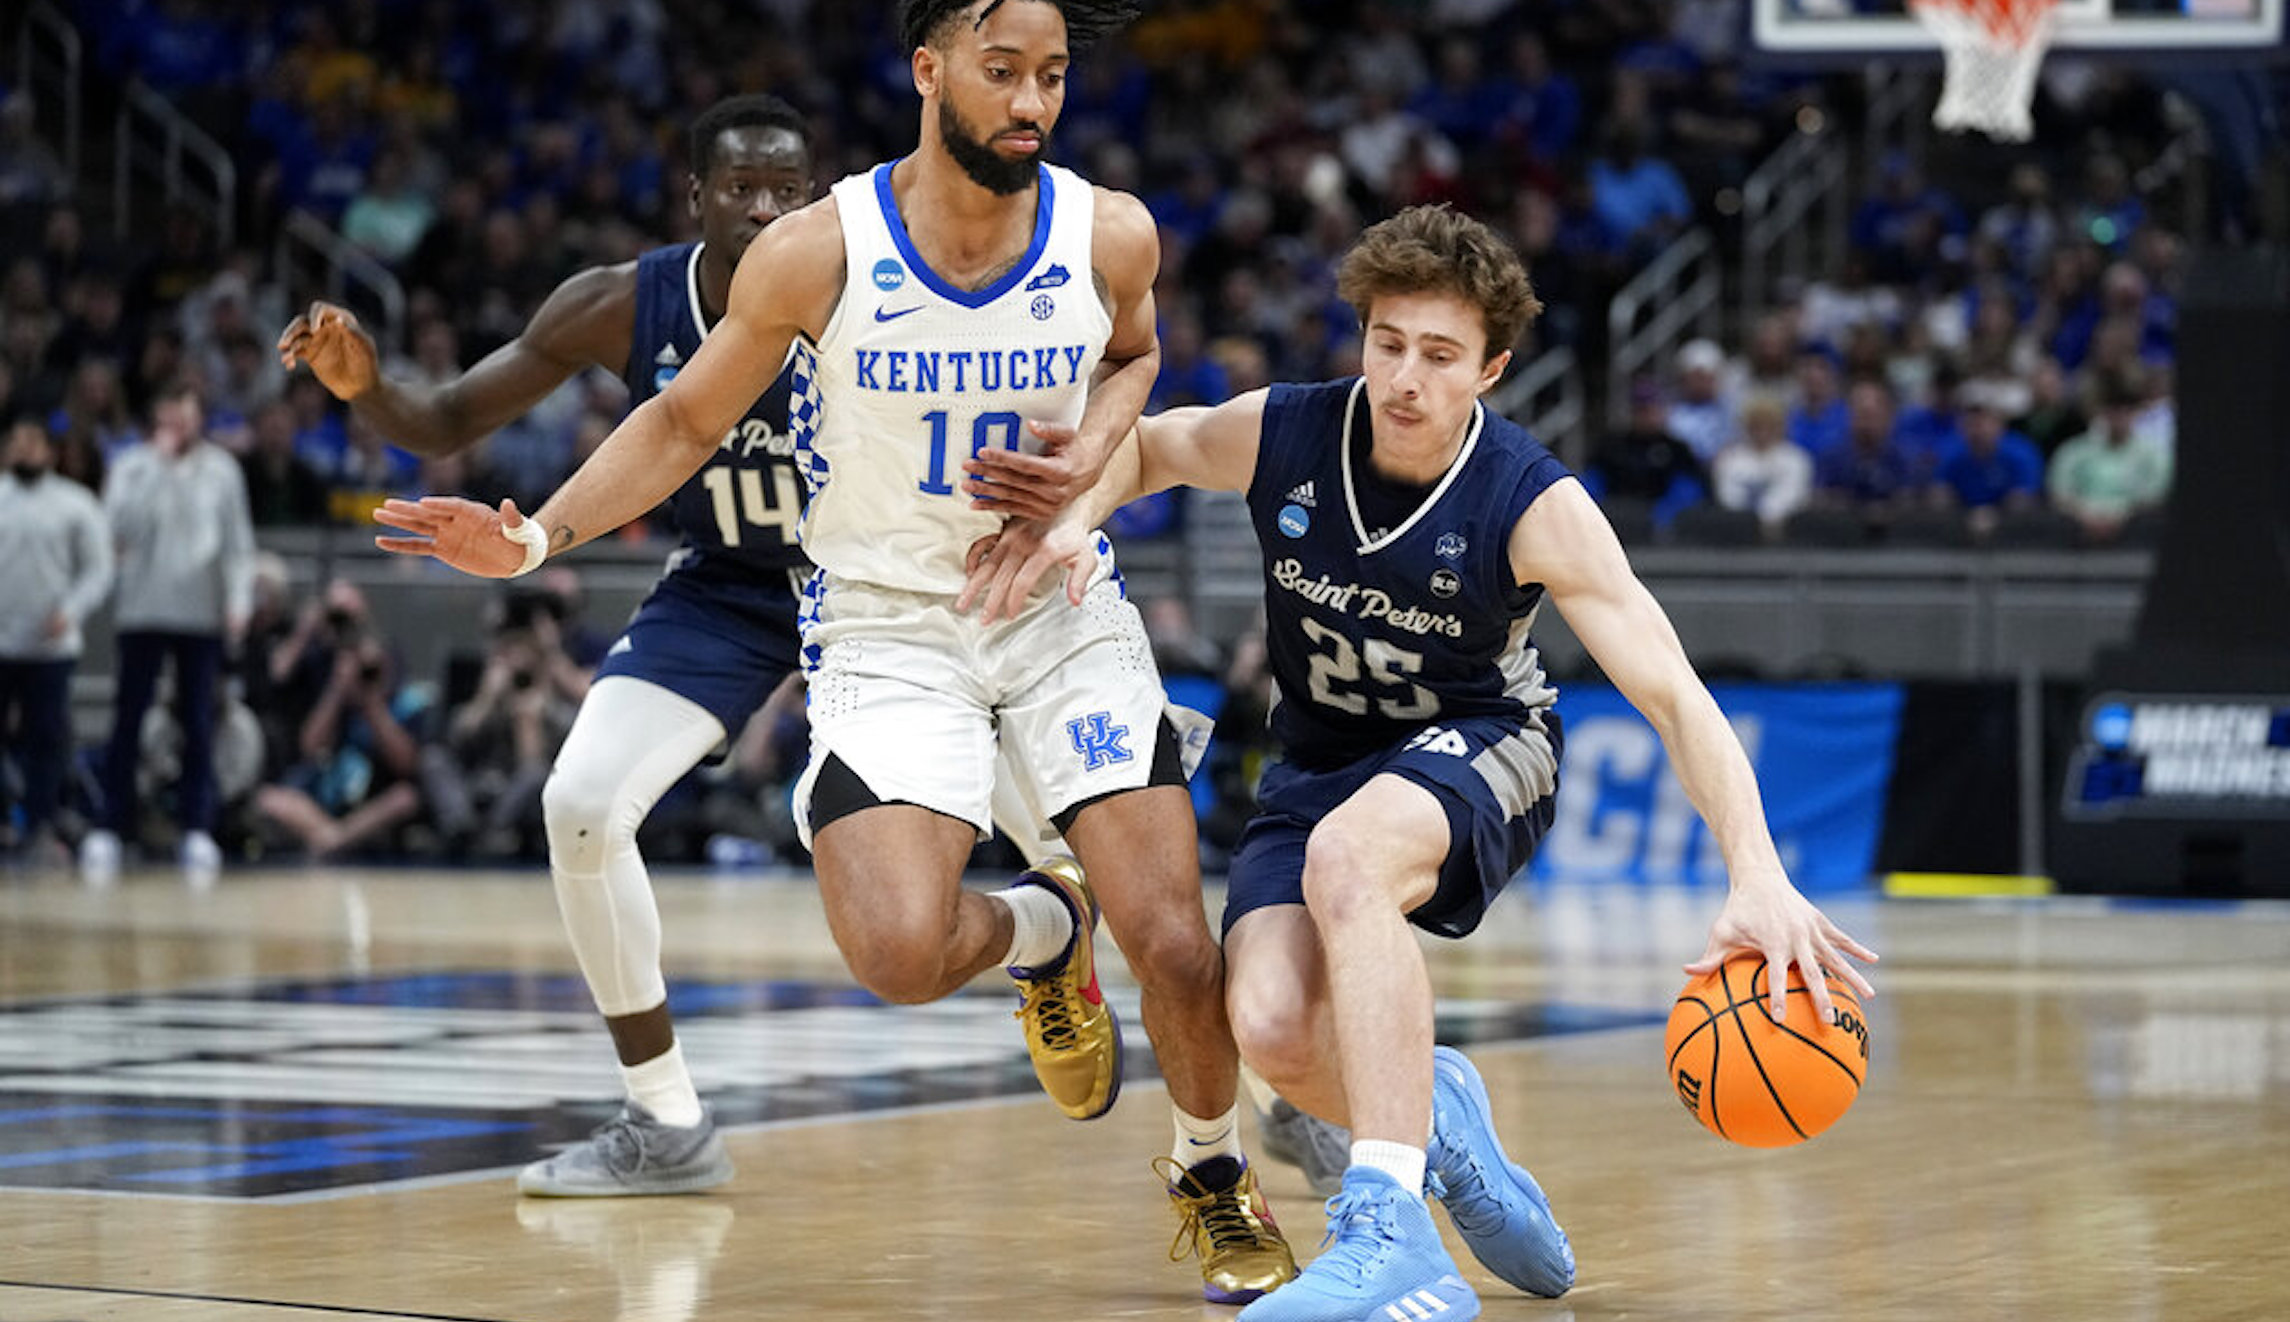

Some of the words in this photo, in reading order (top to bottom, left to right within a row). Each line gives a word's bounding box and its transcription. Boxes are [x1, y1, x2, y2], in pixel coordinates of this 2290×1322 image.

[855, 345, 1087, 393] KENTUCKY
[918, 410, 1022, 500] 10
[702, 464, 801, 548] 14
[1272, 558, 1361, 614] Saint
[1357, 588, 1463, 638] Peter's
[1301, 616, 1442, 720] 25
